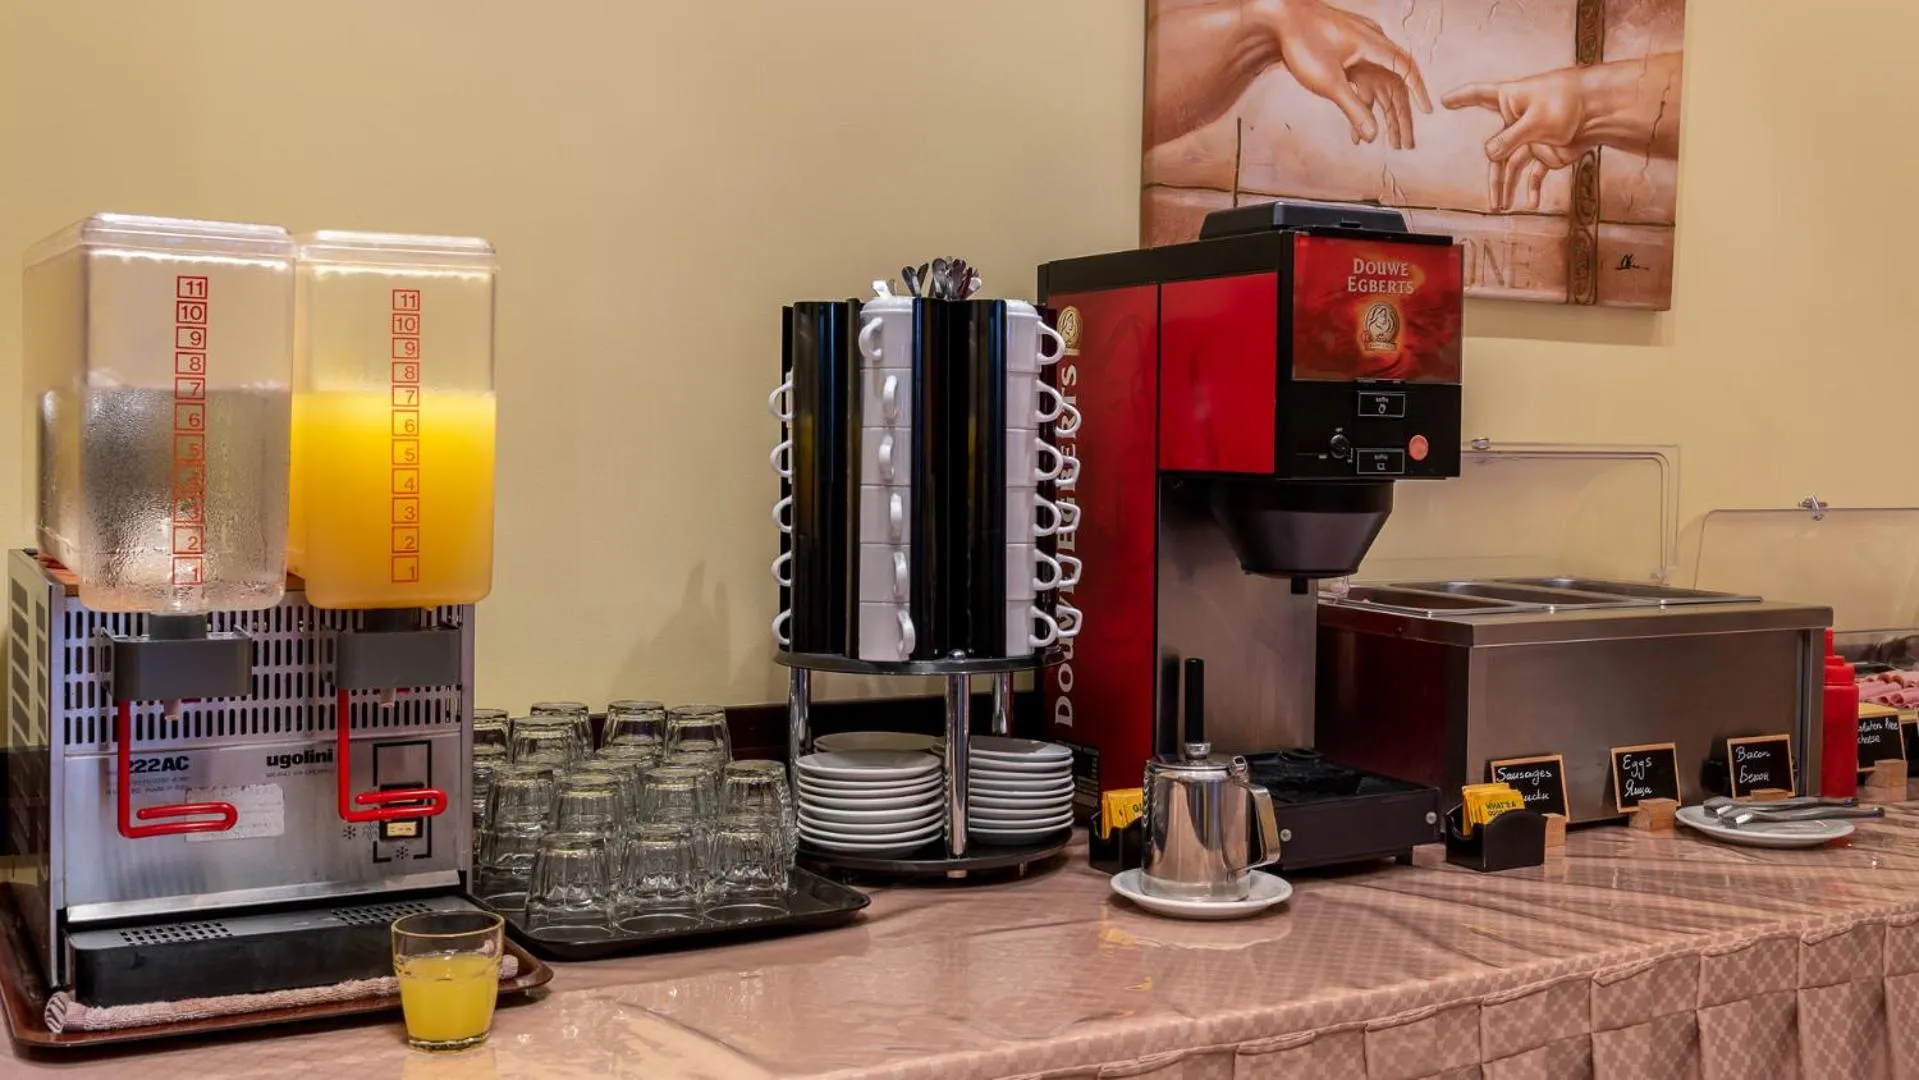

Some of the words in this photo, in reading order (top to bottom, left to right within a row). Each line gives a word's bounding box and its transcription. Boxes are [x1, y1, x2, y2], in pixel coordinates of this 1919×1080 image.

[1353, 257, 1409, 277] DOUWE
[185, 280, 204, 296] 11
[1347, 276, 1414, 294] EGBERTS
[400, 294, 416, 309] 11
[181, 305, 202, 321] 10
[396, 317, 416, 332] 10
[266, 749, 333, 769] ugolini
[1736, 746, 1771, 763] Bacon
[1622, 754, 1653, 780] Eggs
[1497, 767, 1553, 786] Sausages
